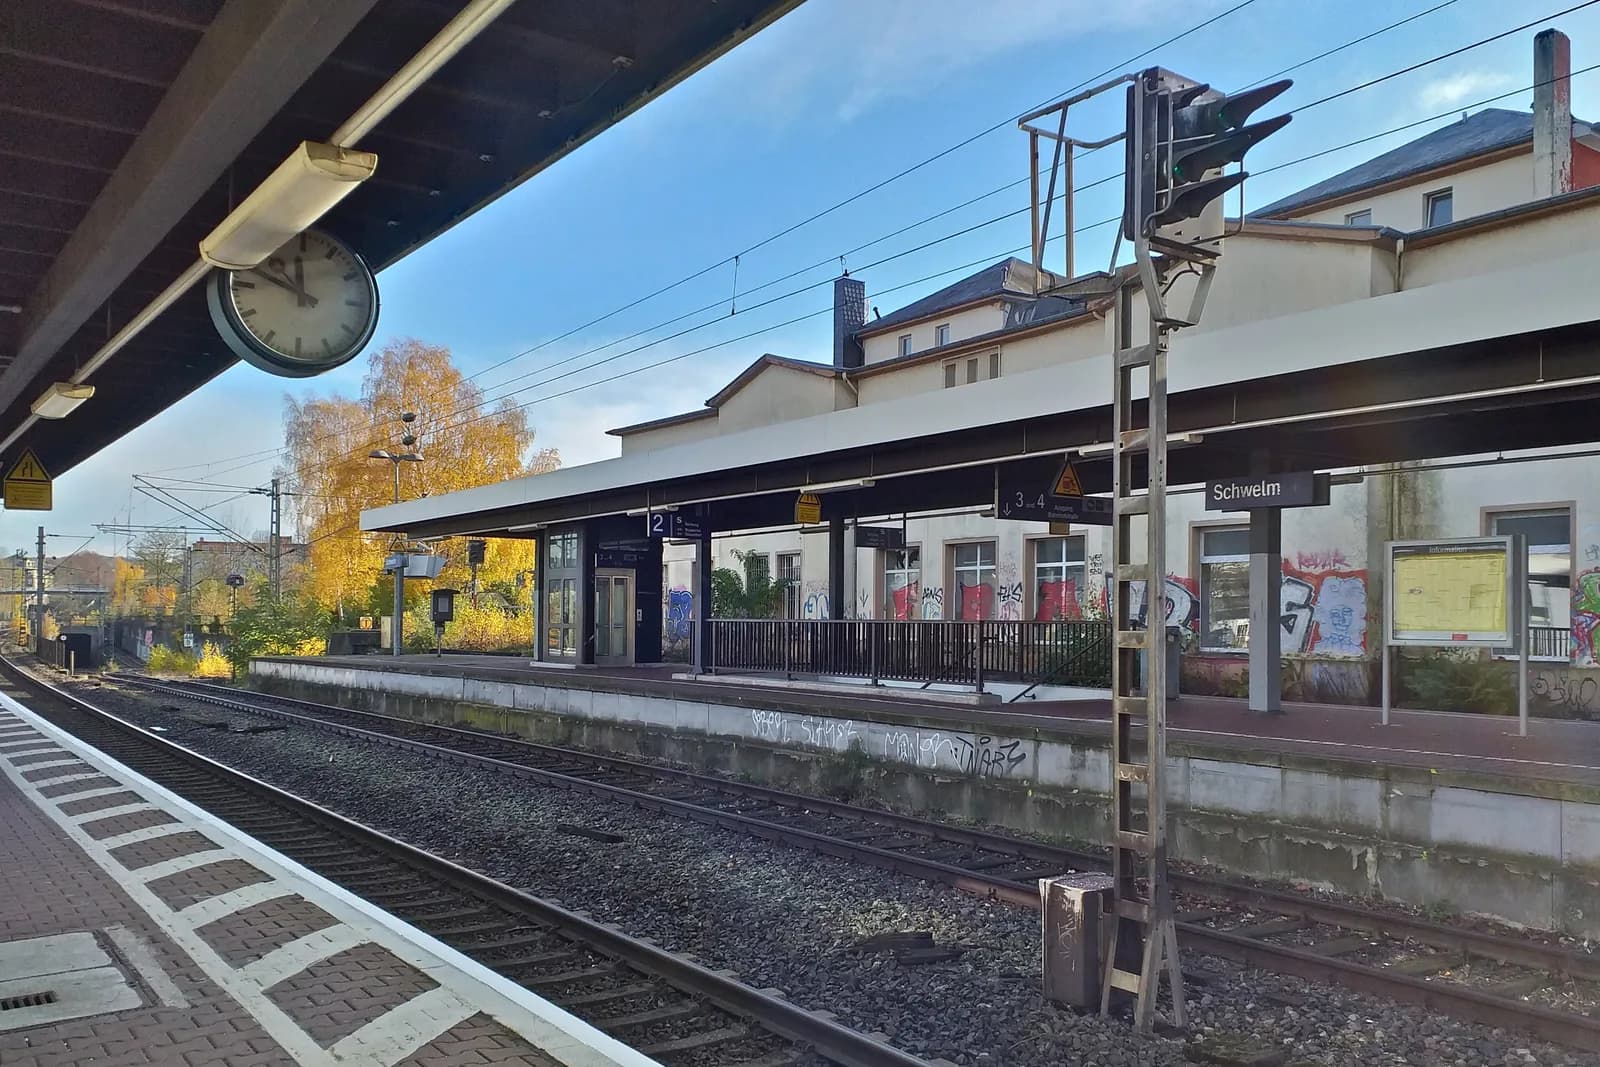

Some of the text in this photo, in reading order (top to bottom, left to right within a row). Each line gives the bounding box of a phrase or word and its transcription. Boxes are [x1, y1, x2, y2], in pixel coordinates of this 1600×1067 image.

[1213, 479, 1281, 501] Schwelm
[1015, 491, 1024, 508] 3
[1037, 493, 1046, 509] 4
[652, 514, 664, 532] 2
